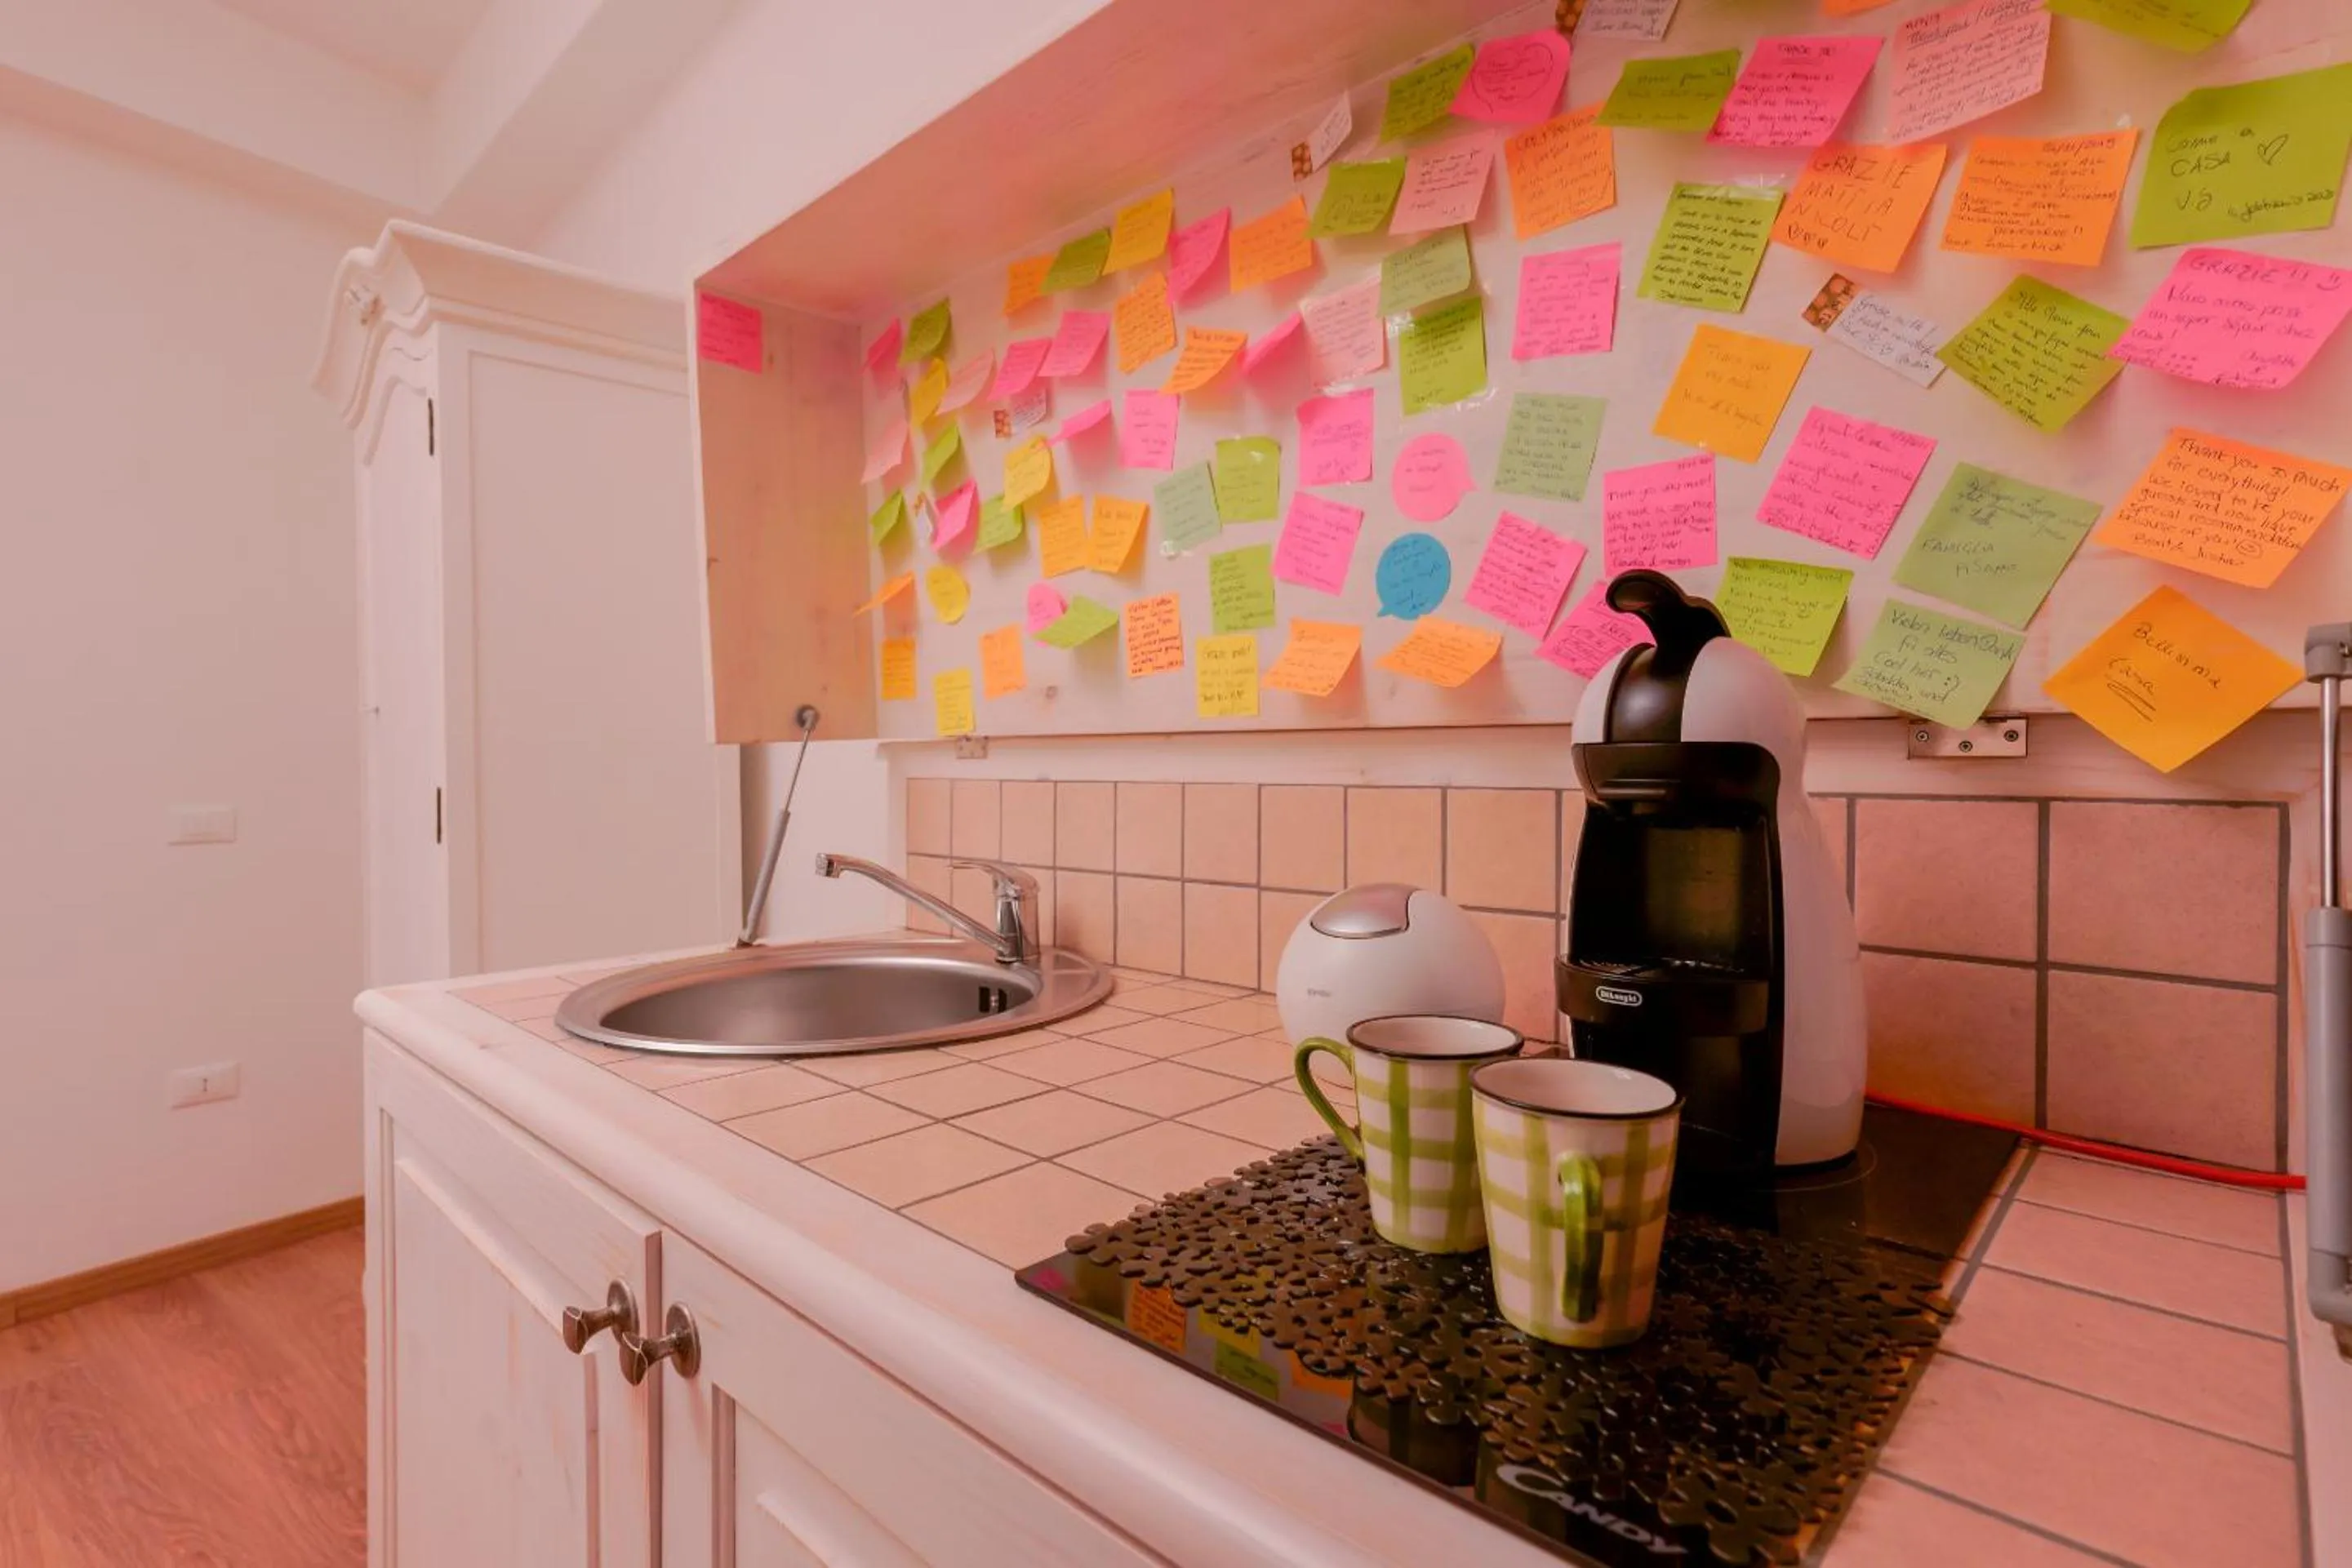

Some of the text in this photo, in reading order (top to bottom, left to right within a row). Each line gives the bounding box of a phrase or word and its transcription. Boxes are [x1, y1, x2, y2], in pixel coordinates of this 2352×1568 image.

[1812, 153, 1919, 189] GRAZIE
[2170, 150, 2232, 177] CASA
[2189, 255, 2279, 283] GRAZIE
[2179, 437, 2231, 461] Thank
[1891, 607, 1932, 634] Vielen
